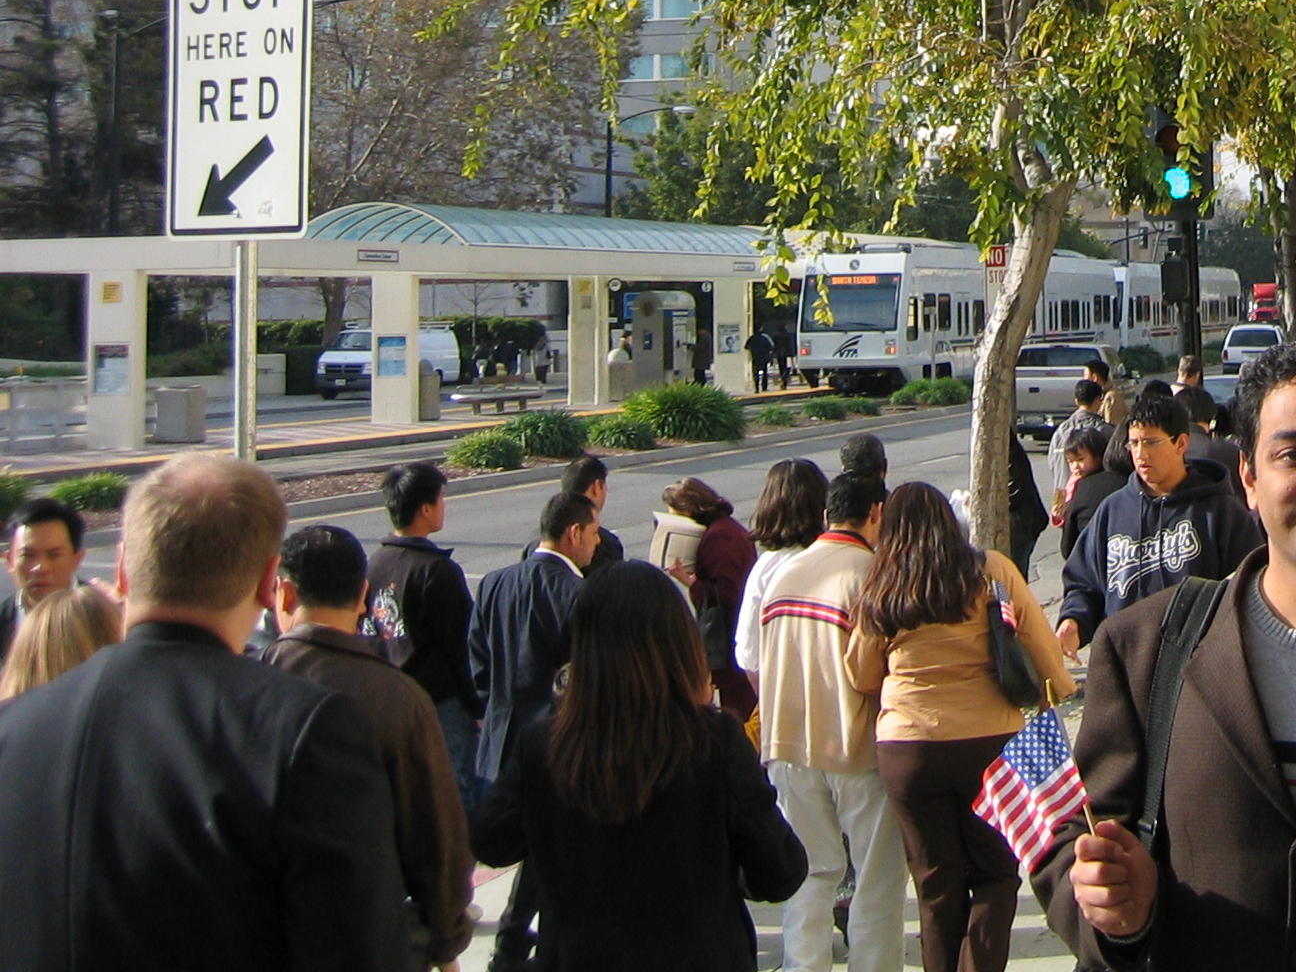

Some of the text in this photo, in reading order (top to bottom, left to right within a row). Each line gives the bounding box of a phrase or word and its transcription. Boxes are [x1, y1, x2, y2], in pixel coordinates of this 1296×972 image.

[187, 27, 294, 61] HERE ON
[199, 76, 279, 123] RED
